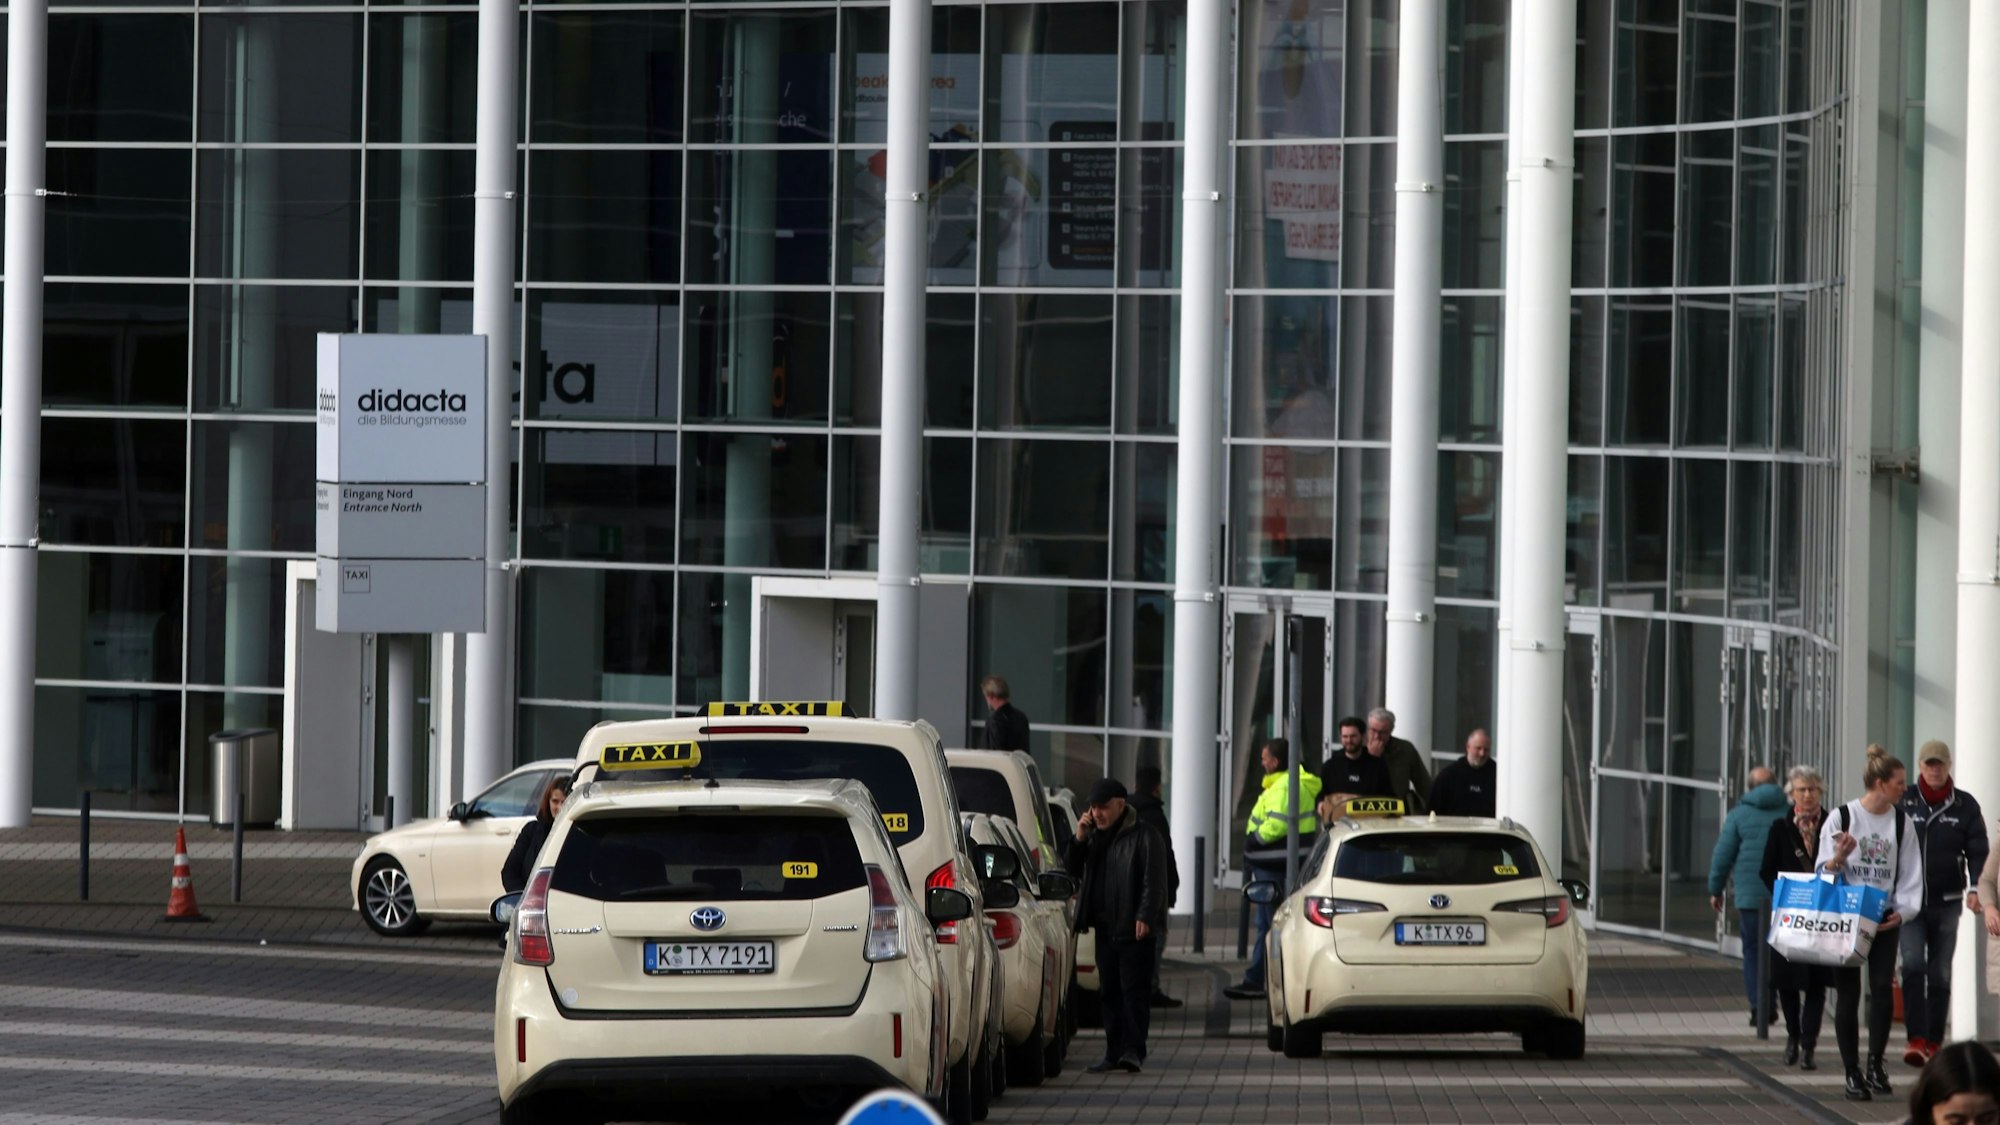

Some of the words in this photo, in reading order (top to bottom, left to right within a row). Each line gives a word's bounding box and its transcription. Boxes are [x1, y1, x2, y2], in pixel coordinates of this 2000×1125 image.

[358, 389, 467, 412] didacta
[358, 414, 377, 426] die
[380, 414, 467, 428] Bildungsmesse
[343, 488, 384, 500] Eingang
[387, 488, 413, 499] Nord
[343, 502, 389, 513] Entrance
[391, 502, 422, 513] North
[345, 570, 368, 580] TAXI
[734, 703, 815, 715] TAXI
[615, 744, 680, 762] TAXI
[1358, 801, 1392, 811] TAXI
[789, 864, 810, 876] 191
[1851, 865, 1869, 878] NEW
[1873, 867, 1892, 880] YORK
[1793, 915, 1852, 933] Betzold
[1414, 925, 1424, 940] K
[1434, 925, 1453, 940] TX
[1456, 926, 1474, 940] 96
[659, 946, 671, 966] K
[687, 946, 712, 966] TX
[718, 946, 770, 965] 7191
